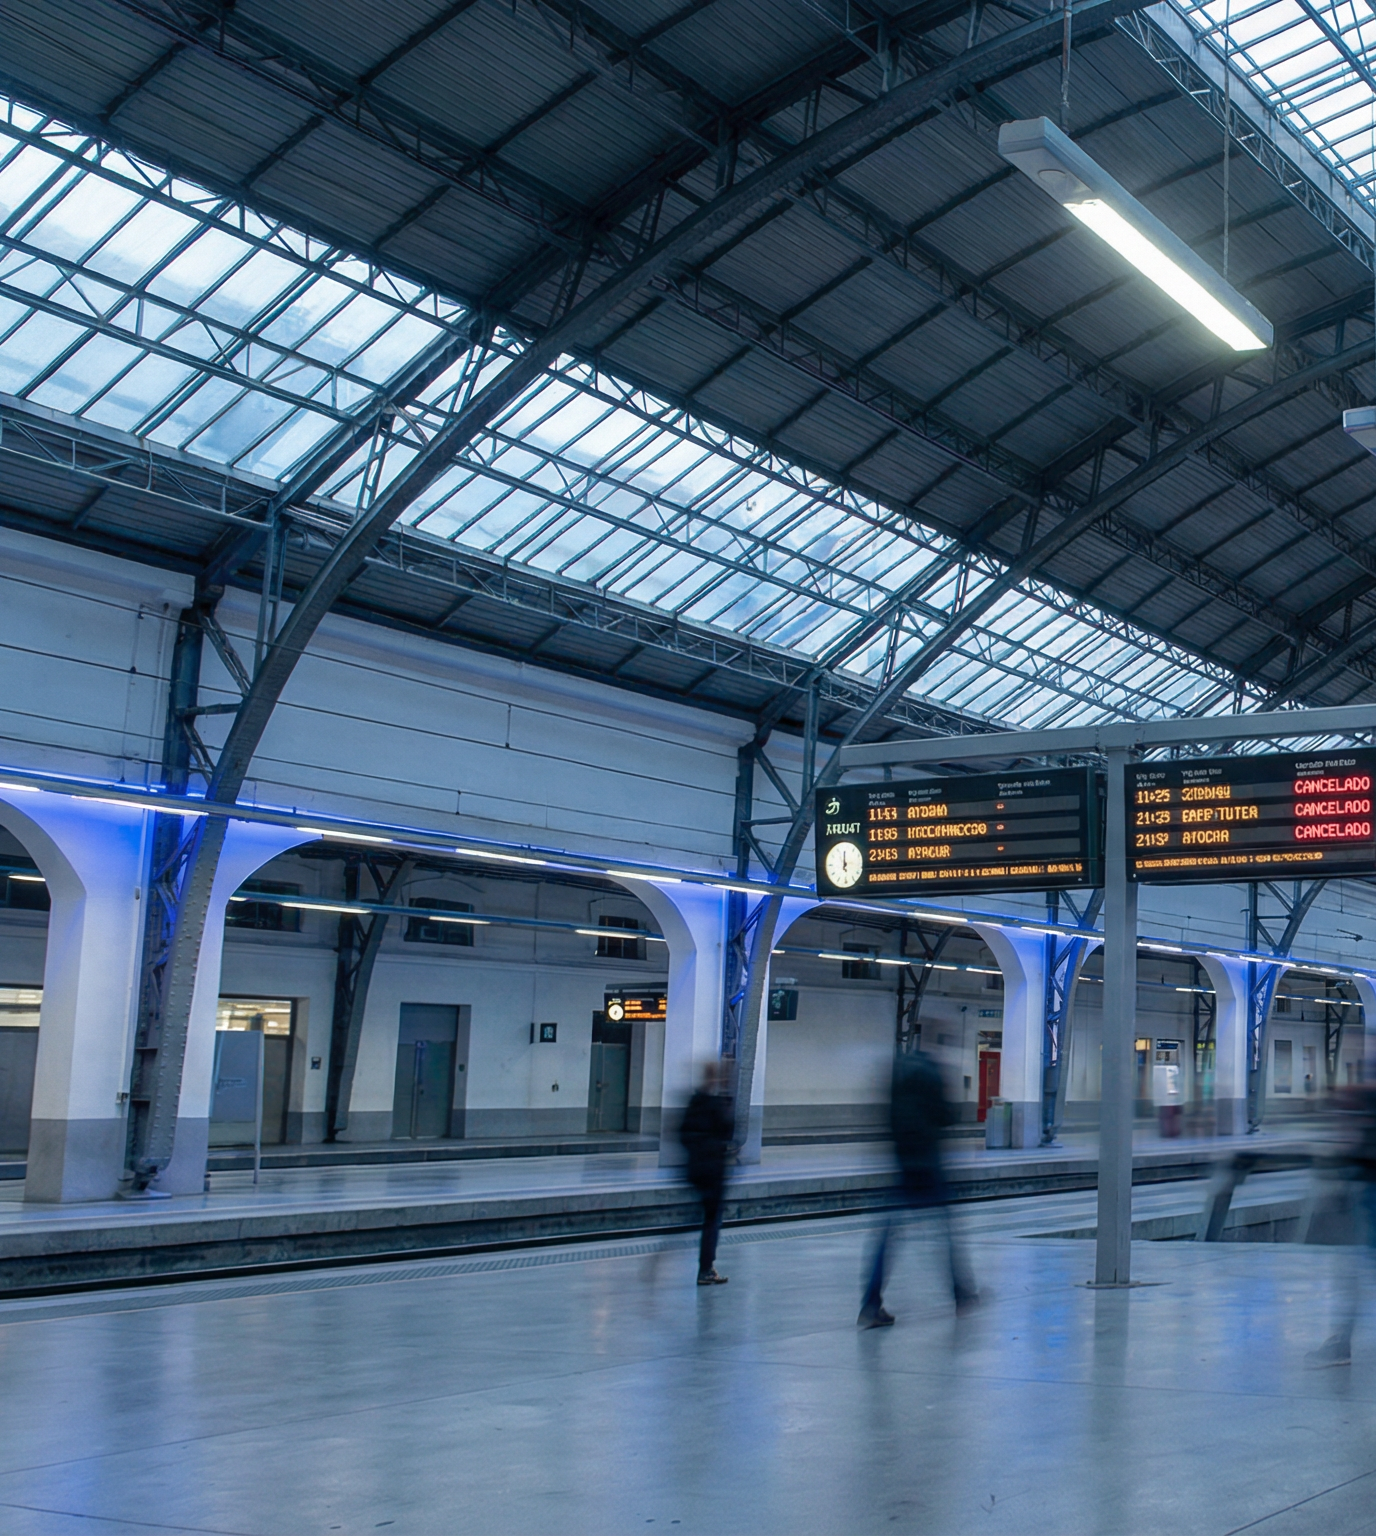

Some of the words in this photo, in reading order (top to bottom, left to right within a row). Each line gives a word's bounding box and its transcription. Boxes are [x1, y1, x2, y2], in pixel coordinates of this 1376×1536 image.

[1294, 776, 1371, 794] CANCELADO
[1294, 799, 1371, 817] CANCELADO
[1294, 822, 1371, 839] CANCELADO
